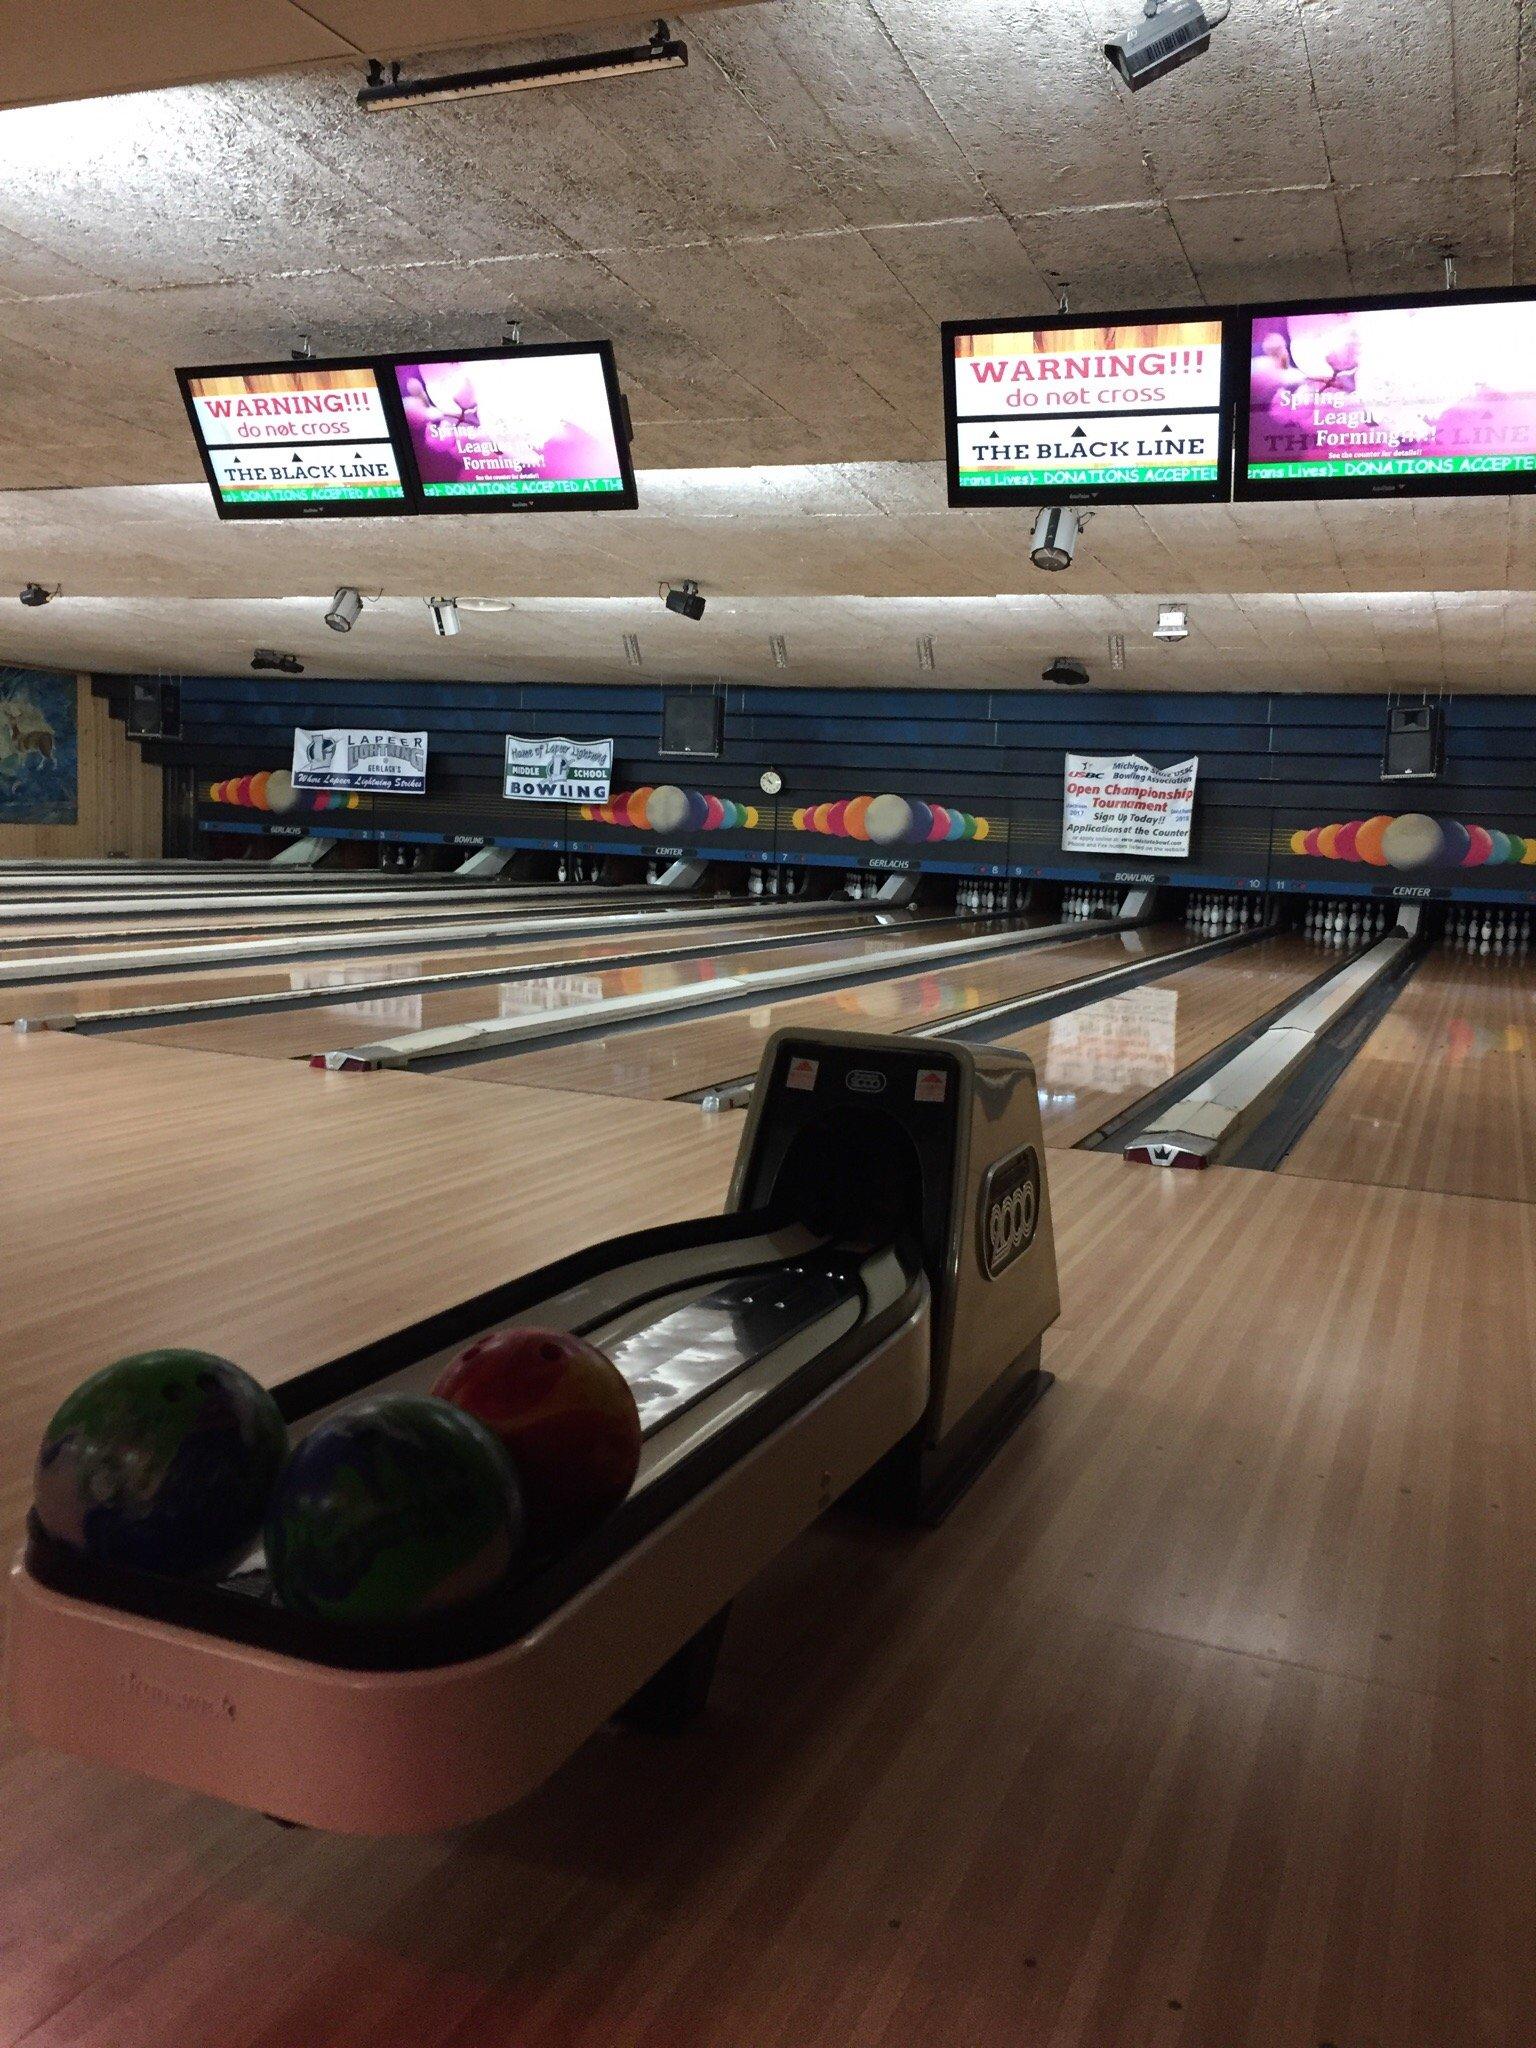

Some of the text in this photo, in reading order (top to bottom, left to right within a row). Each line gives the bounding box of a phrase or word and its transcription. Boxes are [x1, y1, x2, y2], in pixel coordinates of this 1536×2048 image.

[970, 350, 1203, 384] WARNING!!!
[1006, 388, 1038, 407] do
[1097, 387, 1166, 403] cross
[204, 392, 370, 418] WARNING!!!
[1313, 409, 1385, 428] Leagu
[238, 422, 261, 438] do
[302, 421, 350, 436] cross
[456, 438, 507, 456] Leagu
[972, 438, 1204, 461] THE BLACK LINE
[1342, 451, 1352, 459] the
[1354, 451, 1381, 459] counter
[1344, 458, 1454, 476] DONATIONS
[1459, 455, 1536, 473] ACCEPTE
[224, 464, 389, 482] THE BLACK LINE
[1043, 469, 1139, 485] DONATIONS
[241, 488, 308, 501] DONATIONS
[311, 487, 360, 500] ACCEPTED
[367, 487, 382, 498] AT
[445, 481, 518, 496] DONATIONS
[522, 480, 579, 493] ACCEPTED
[582, 479, 599, 491] AT
[347, 735, 422, 748] LAPEER
[512, 748, 534, 759] Home
[535, 745, 544, 758] of
[512, 766, 607, 778] MIDDLE SCHOOL
[1113, 761, 1149, 773] Michigan
[298, 774, 421, 788] Where Lapeer Lightning Strikes
[1067, 771, 1104, 779] USBC
[1112, 772, 1192, 784] Bowling Association
[510, 782, 606, 798] BOWLING
[1066, 783, 1193, 802] Open Championship
[1092, 797, 1168, 813] Tournament
[1093, 812, 1167, 825] Sign Up Today!!
[1066, 823, 1122, 834] Applications
[1134, 826, 1150, 836] the
[1152, 828, 1189, 837] Counter
[453, 836, 484, 845] BOWLING
[655, 847, 683, 856] CENTER
[761, 853, 768, 861] 6
[782, 853, 788, 861] 7
[869, 858, 909, 869] GERLACHS
[992, 865, 999, 874] 8
[1015, 867, 1022, 875] 9
[1114, 873, 1155, 883] BOWLING
[1250, 879, 1261, 888] 10
[1276, 880, 1285, 889] 11
[1392, 886, 1431, 896] CENTER
